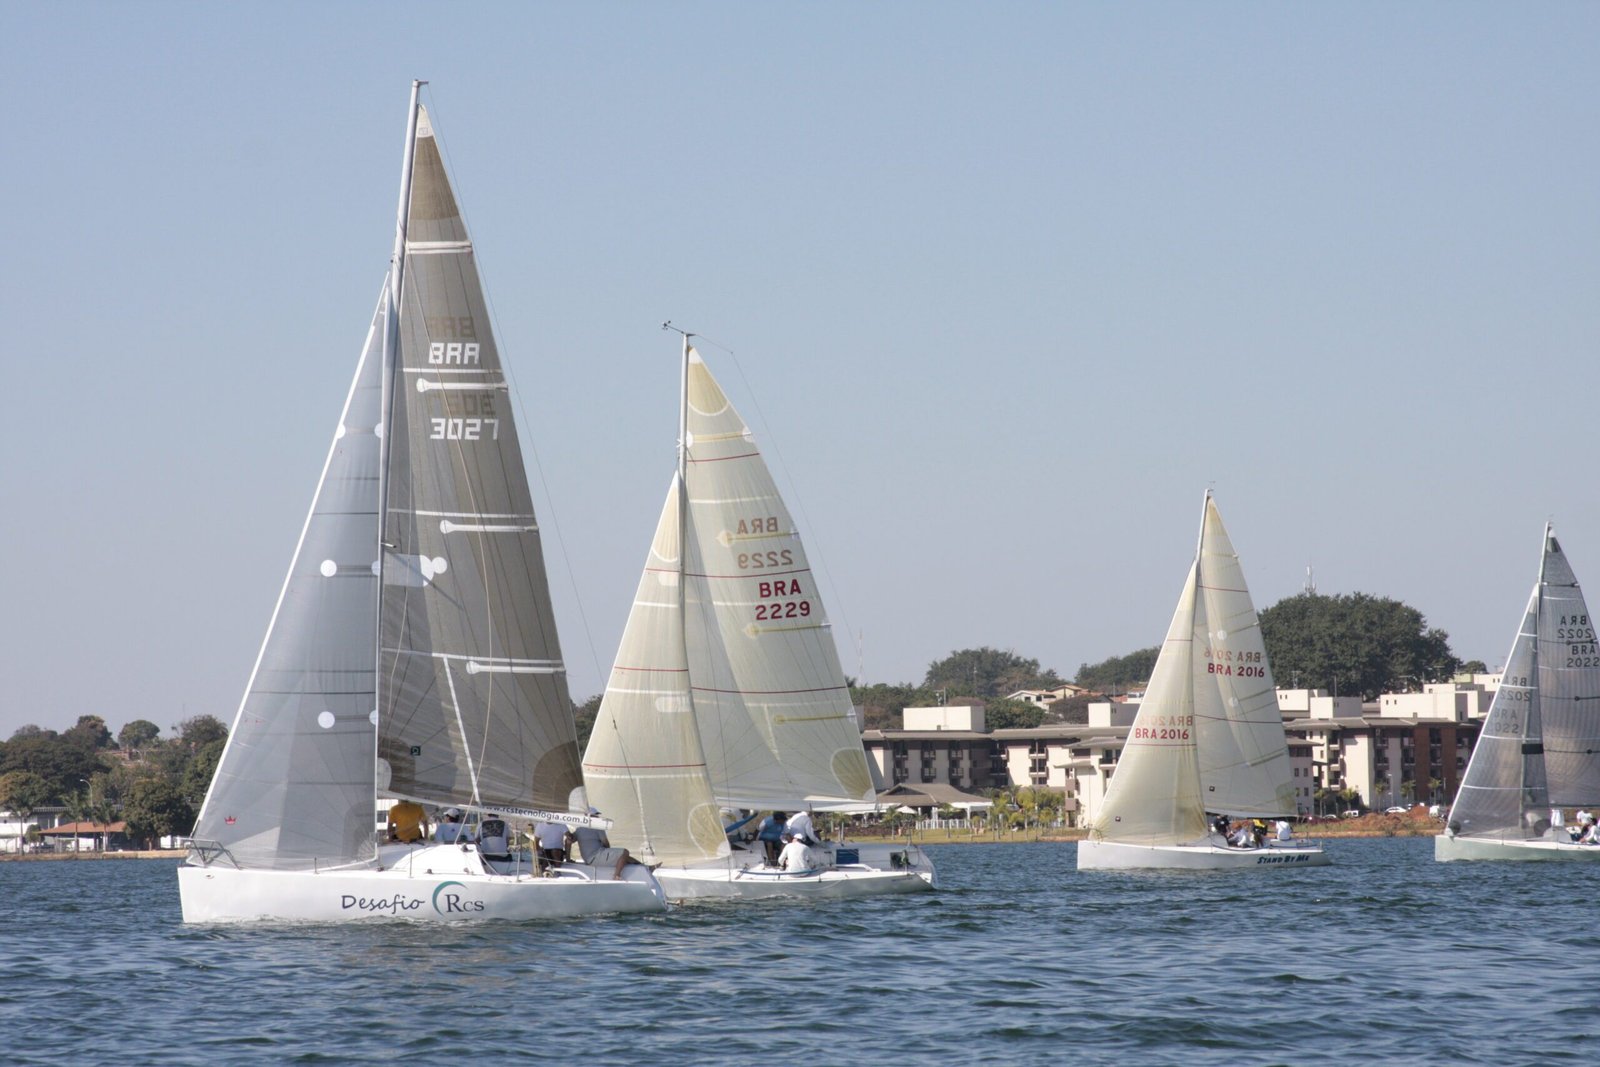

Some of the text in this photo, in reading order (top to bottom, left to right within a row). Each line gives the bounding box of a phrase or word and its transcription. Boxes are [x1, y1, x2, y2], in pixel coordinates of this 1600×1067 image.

[428, 342, 480, 365] BRA
[430, 418, 499, 440] 3027
[759, 579, 802, 598] BRA
[755, 601, 811, 621] 2229
[1571, 644, 1596, 655] BRA
[1207, 662, 1265, 678] BRA 2016
[1566, 656, 1600, 668] 2022
[1135, 727, 1190, 740] BRA 2016
[1491, 721, 1519, 734] 022
[341, 894, 426, 915] Desafio
